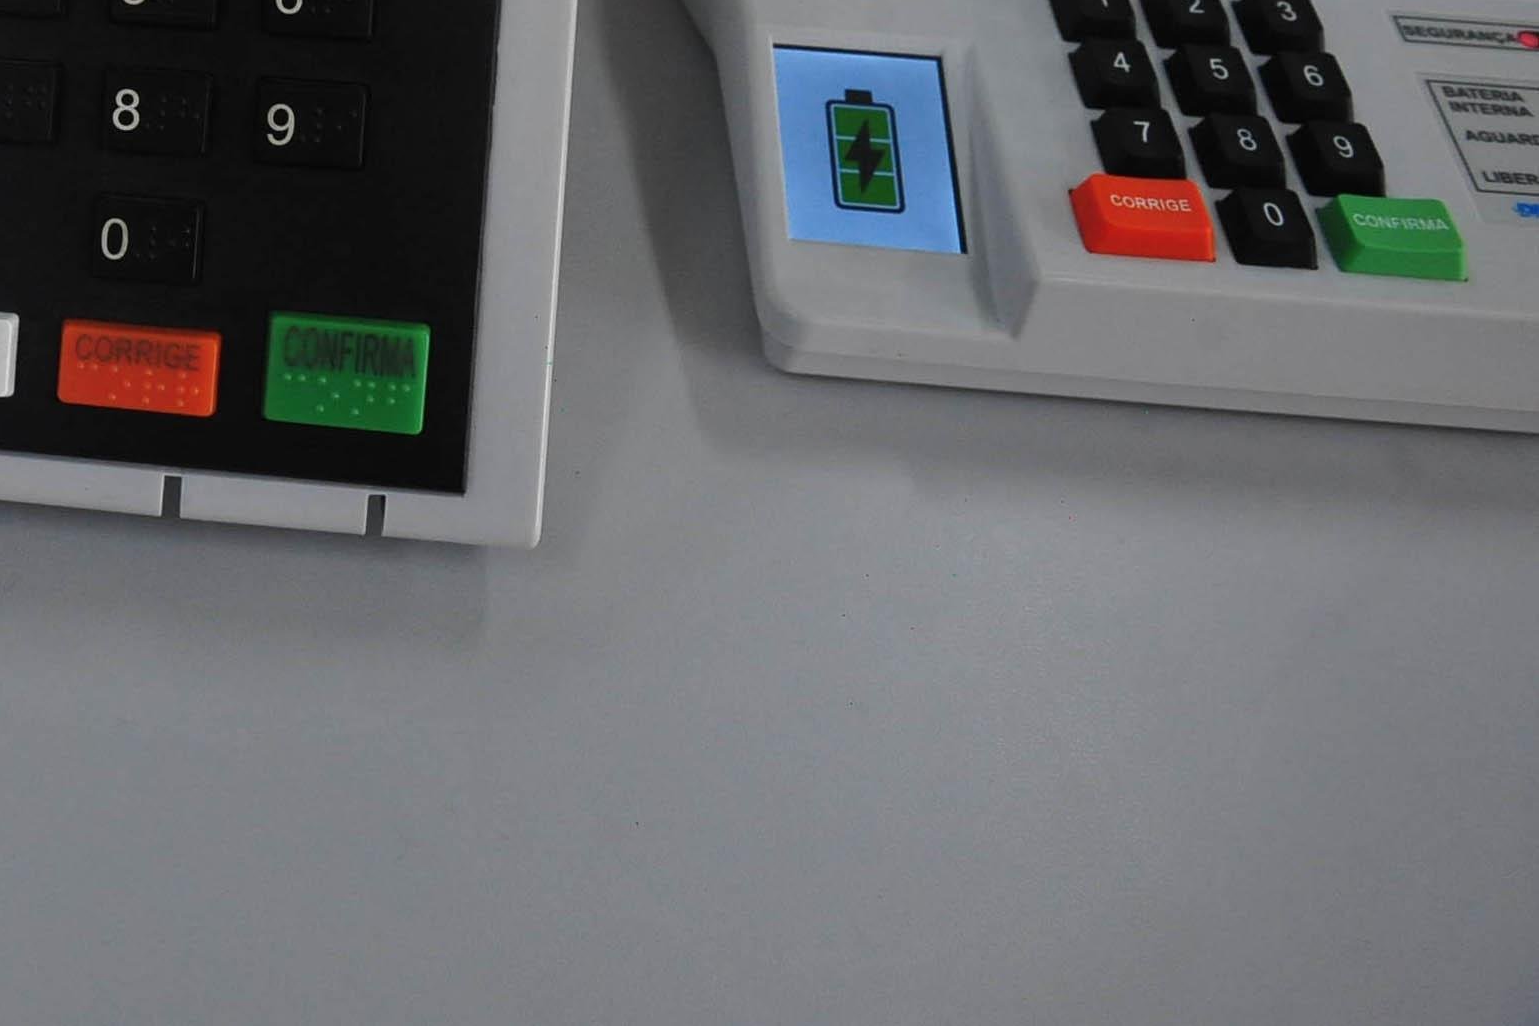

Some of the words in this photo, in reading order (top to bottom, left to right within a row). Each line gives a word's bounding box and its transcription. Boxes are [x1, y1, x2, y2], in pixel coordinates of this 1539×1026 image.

[1276, 0, 1297, 22] 3
[1113, 51, 1131, 73] 4
[1209, 58, 1229, 80] 5
[1303, 65, 1324, 87] 6
[1441, 85, 1524, 103] BATERIA
[112, 88, 140, 131] 8
[1448, 101, 1535, 118] INTERNA
[267, 103, 296, 146] 9
[1133, 120, 1151, 143] 7
[1236, 128, 1257, 151] 8
[1332, 135, 1354, 158] 9
[1109, 194, 1193, 213] CORRIGE
[1263, 202, 1284, 227] 0
[1351, 212, 1450, 232] CONFIRMA
[101, 217, 129, 260] 0
[73, 332, 203, 371] CORRIGE
[281, 324, 418, 379] CONFIRMA
